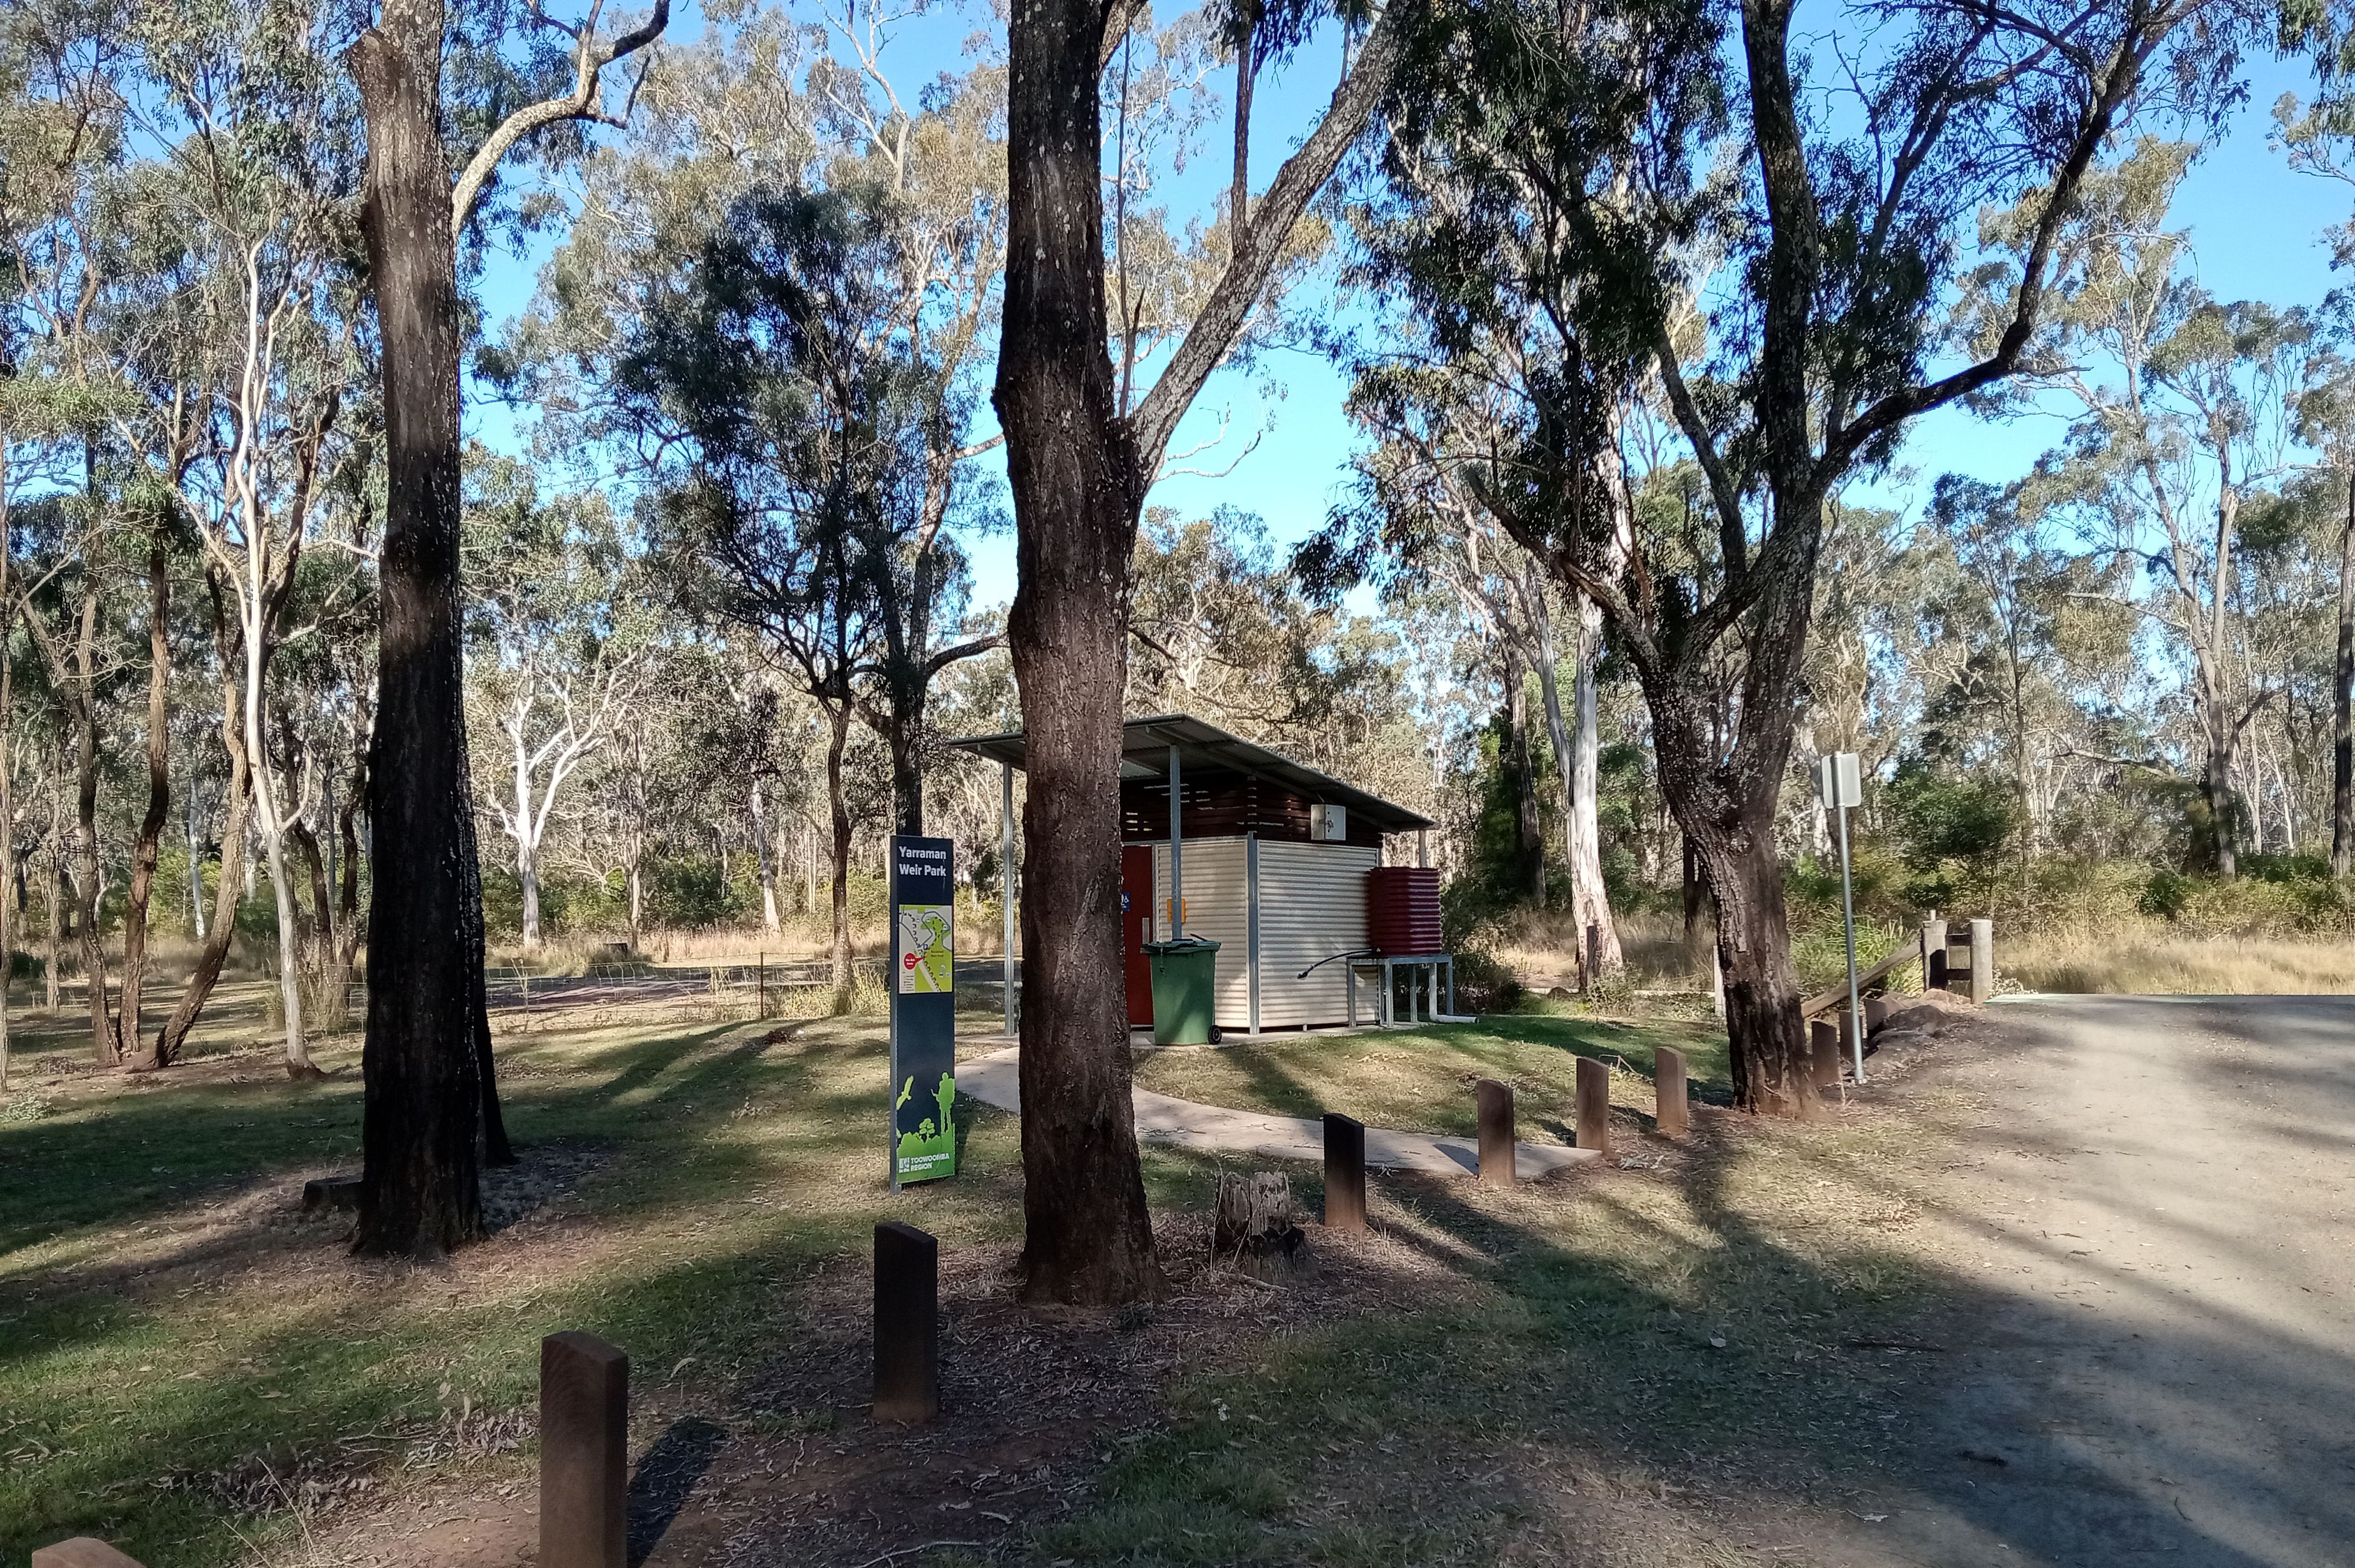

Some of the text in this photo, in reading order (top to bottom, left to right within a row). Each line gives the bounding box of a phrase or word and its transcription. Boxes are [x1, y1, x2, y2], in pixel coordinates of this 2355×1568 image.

[898, 846, 946, 859] Yarraman
[898, 863, 946, 876] Weir Park
[910, 1162, 933, 1171] REGION
